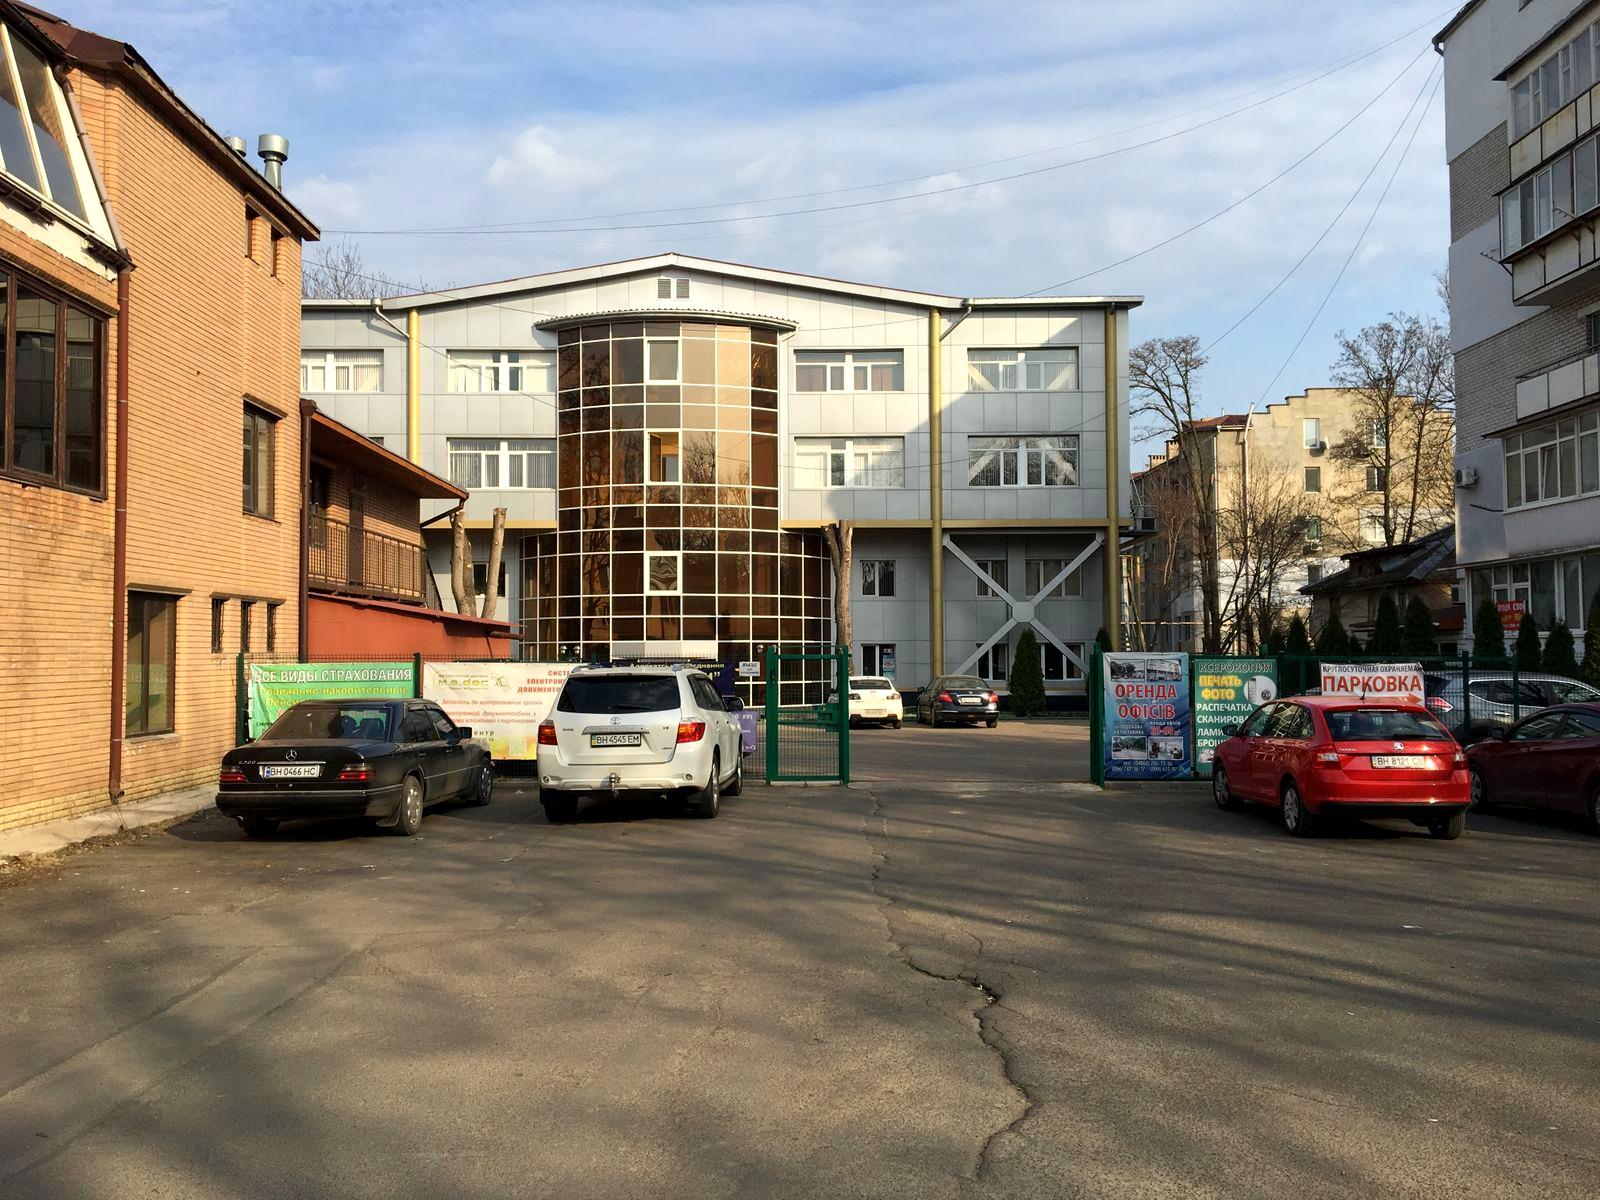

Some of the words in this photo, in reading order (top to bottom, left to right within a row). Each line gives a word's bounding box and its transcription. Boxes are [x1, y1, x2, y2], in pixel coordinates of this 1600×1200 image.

[1199, 661, 1273, 673] КСЕРОКОПИЯ
[1322, 665, 1379, 673] КРУГЛОСУТОЧНАЯ
[280, 670, 317, 683] ВИДЫ
[321, 668, 412, 682] СТРАХОВАНИЯ
[1199, 675, 1242, 687] ПЕЧАТЬ
[1323, 675, 1422, 692] ПАРКОВКА
[1115, 684, 1177, 700] ОРЕНДА
[1201, 688, 1236, 700] ФОТО
[1118, 703, 1176, 719] ОФІСІВ
[1196, 703, 1253, 712] РАСПЕЧАТКА
[1197, 728, 1225, 736] ЛАМИ
[596, 736, 608, 744] BH
[609, 735, 627, 744] 4545
[627, 735, 640, 743] EM
[1198, 739, 1227, 747] БРОШ
[271, 768, 283, 776] BH
[283, 767, 302, 776] 0466
[303, 768, 316, 776] HC
